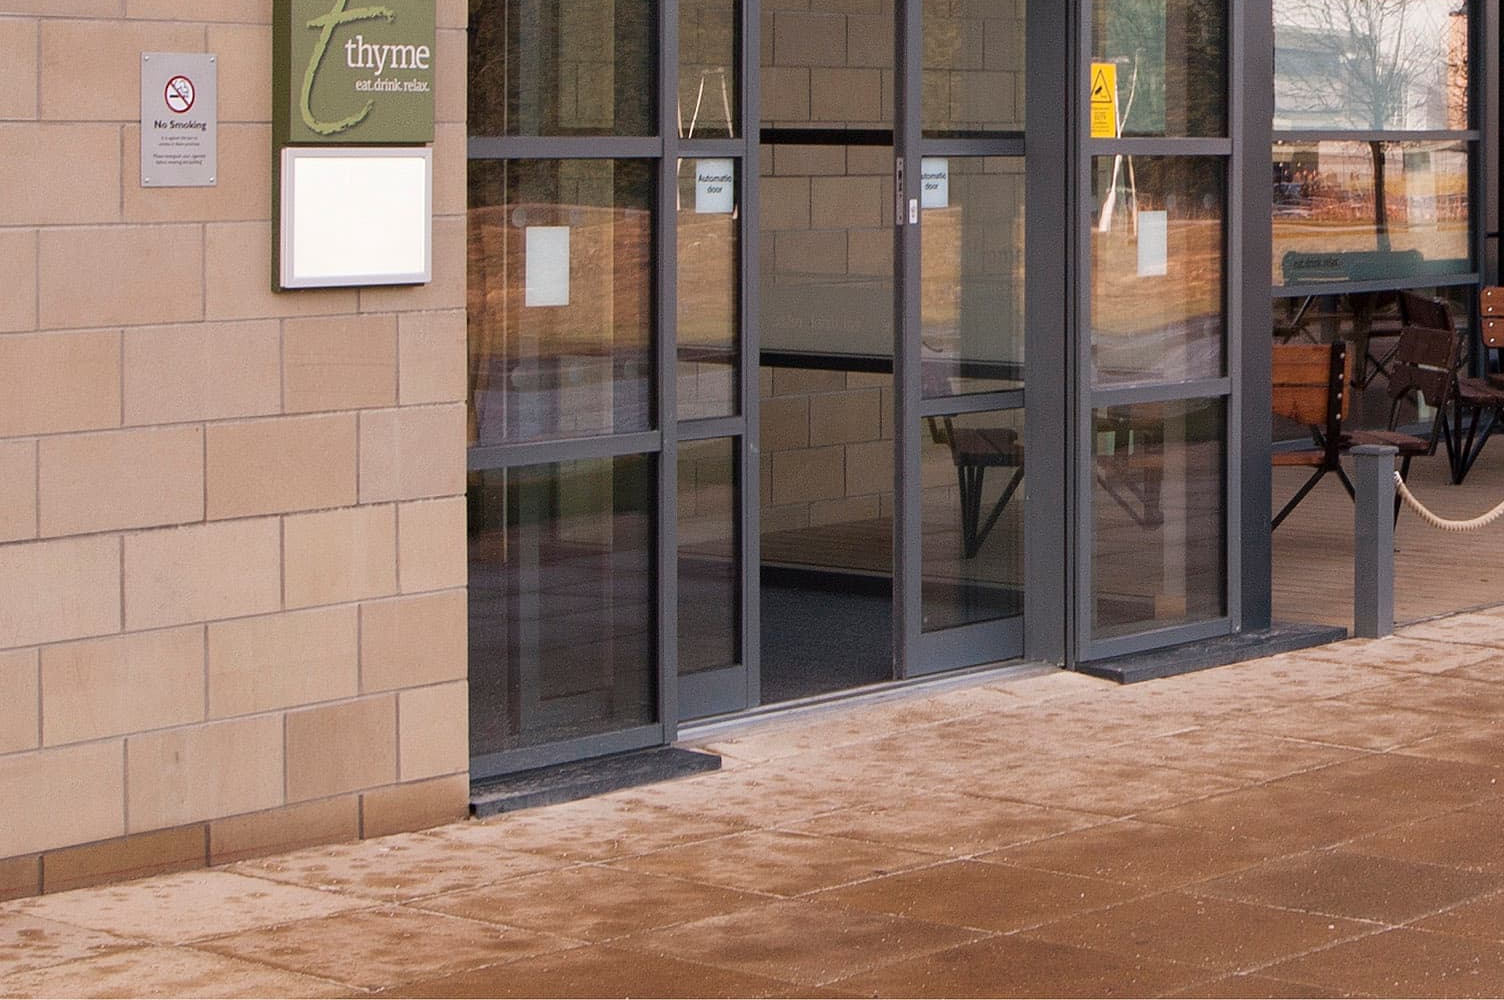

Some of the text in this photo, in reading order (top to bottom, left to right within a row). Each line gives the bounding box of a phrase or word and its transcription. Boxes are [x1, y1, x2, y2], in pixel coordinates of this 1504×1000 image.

[344, 35, 430, 76] thyme
[153, 120, 207, 132] No Smoking
[698, 173, 733, 184] Automatic
[706, 185, 723, 194] door
